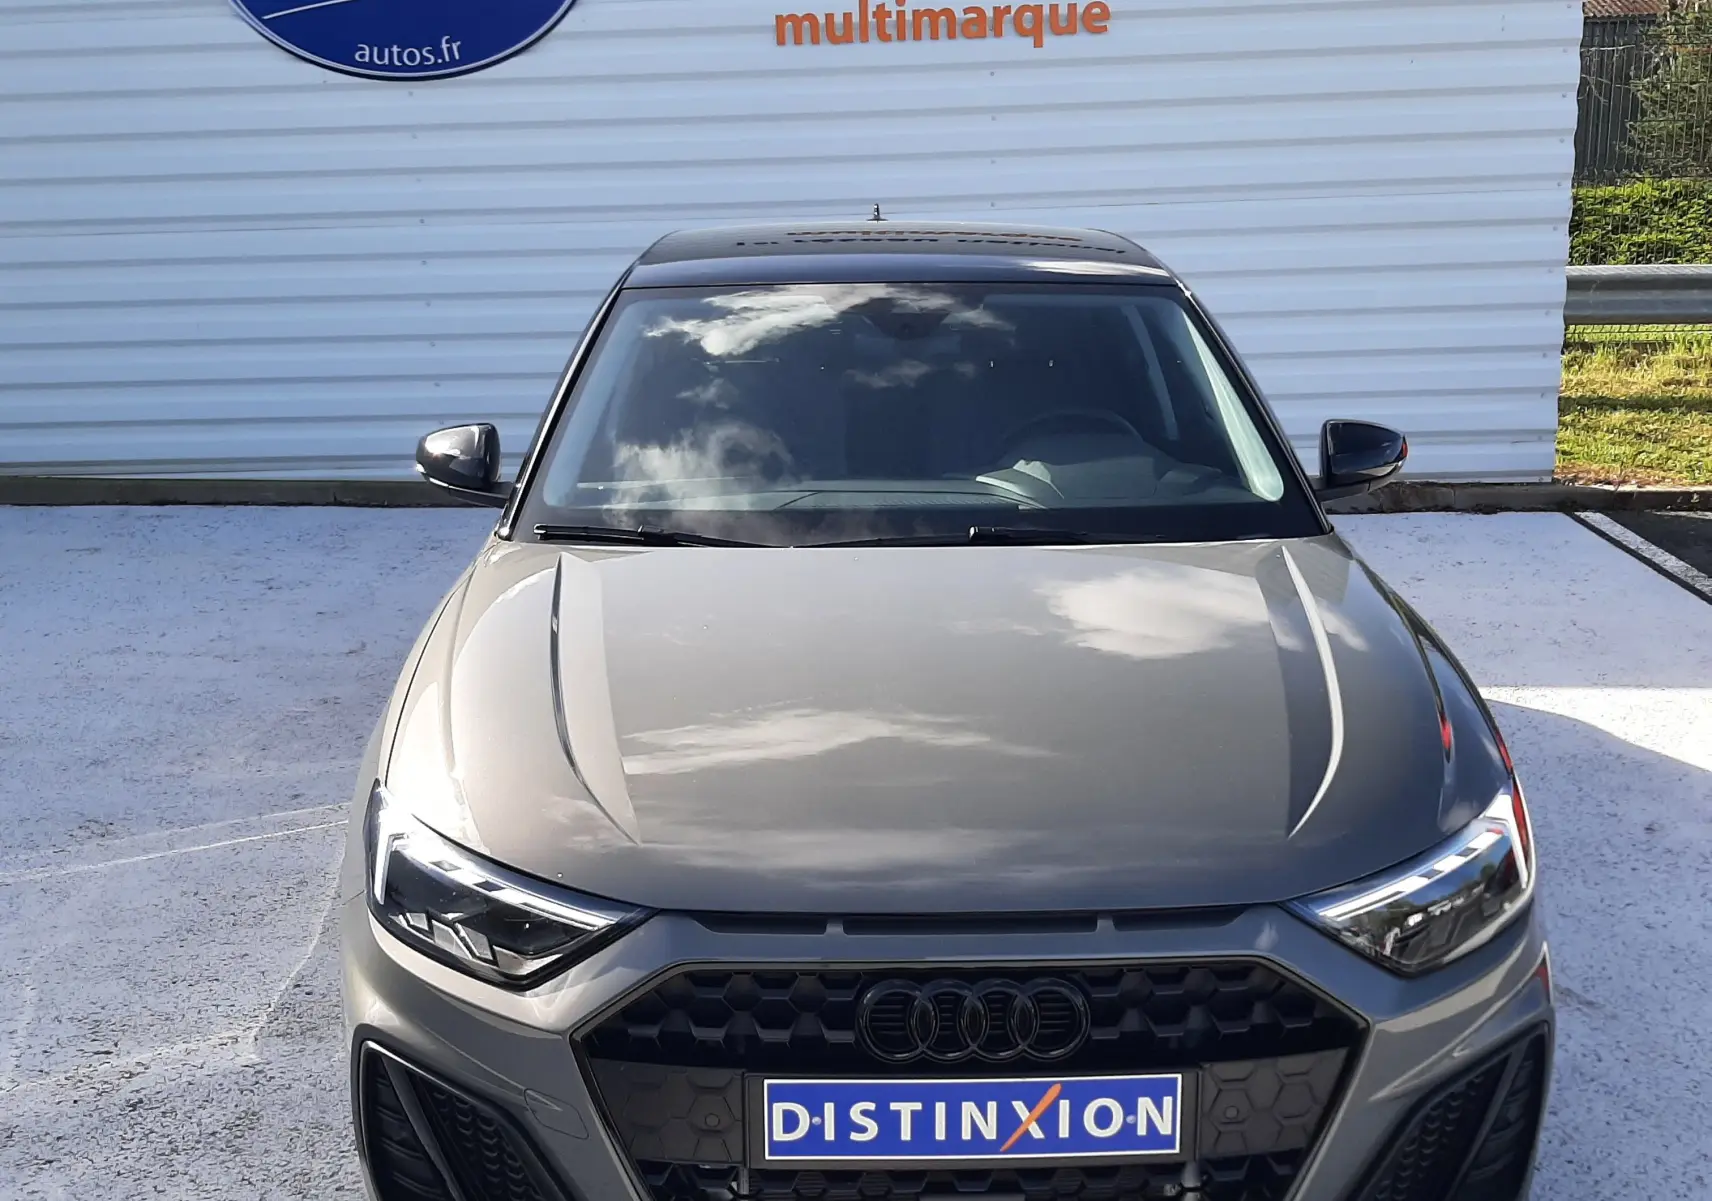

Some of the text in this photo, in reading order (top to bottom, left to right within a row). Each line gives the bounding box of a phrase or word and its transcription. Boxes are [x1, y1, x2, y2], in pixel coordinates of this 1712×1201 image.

[774, 0, 1112, 48] multimarque
[354, 36, 462, 66] autos.fr
[772, 1086, 1174, 1150] DISTINXION
